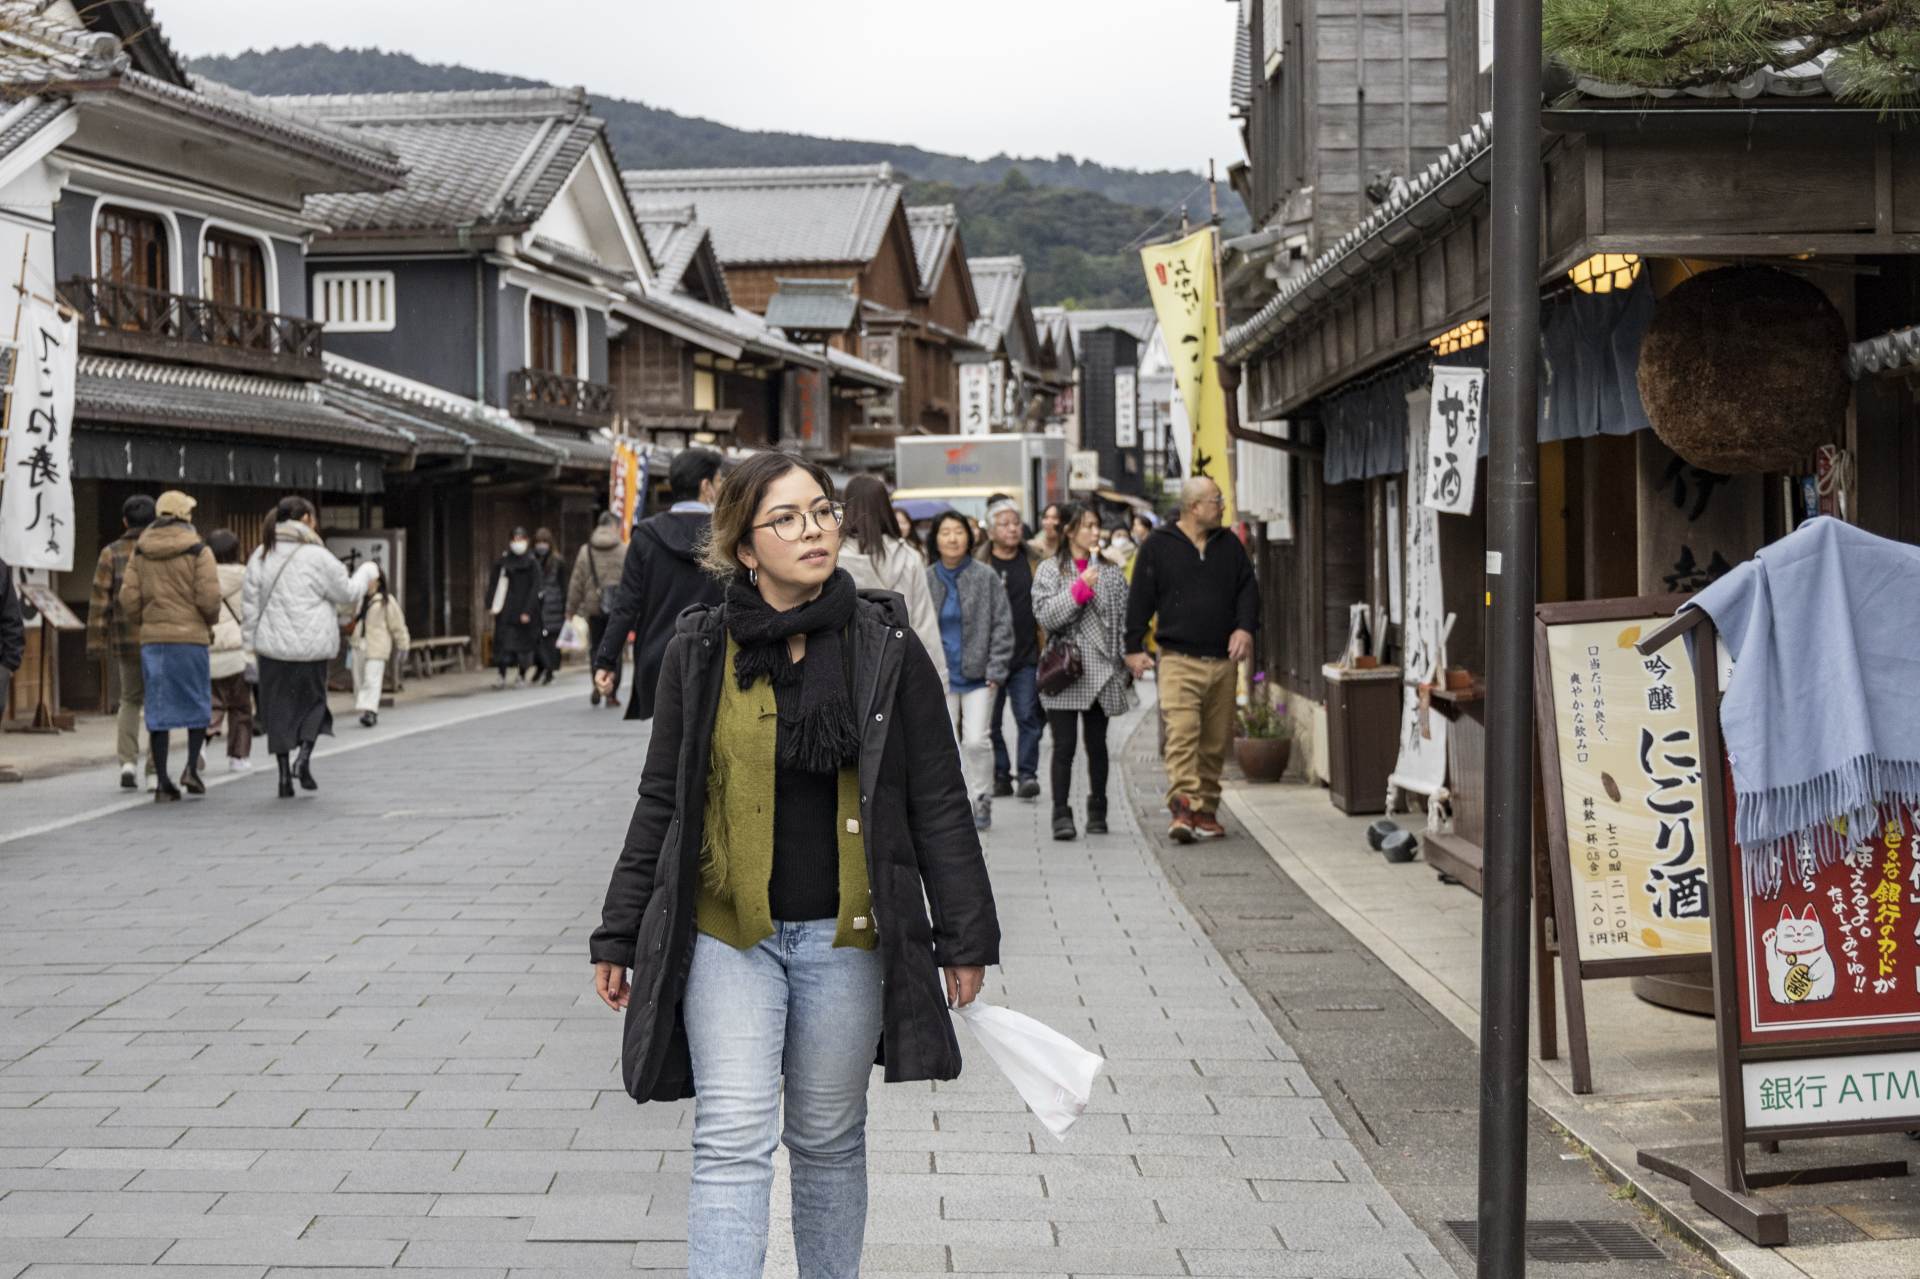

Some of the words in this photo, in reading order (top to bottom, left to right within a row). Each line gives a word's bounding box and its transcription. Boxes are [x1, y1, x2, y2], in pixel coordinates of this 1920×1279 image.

[1432, 384, 1464, 507] 甘酒
[1570, 672, 1589, 764] 爽やかな飲み口
[1588, 646, 1609, 741] 口当たりが良く、
[1643, 654, 1677, 712] 吟醸
[1640, 727, 1710, 918] にごり酒
[1759, 1074, 1828, 1111] 銀行
[1838, 1070, 1920, 1104] ATM
